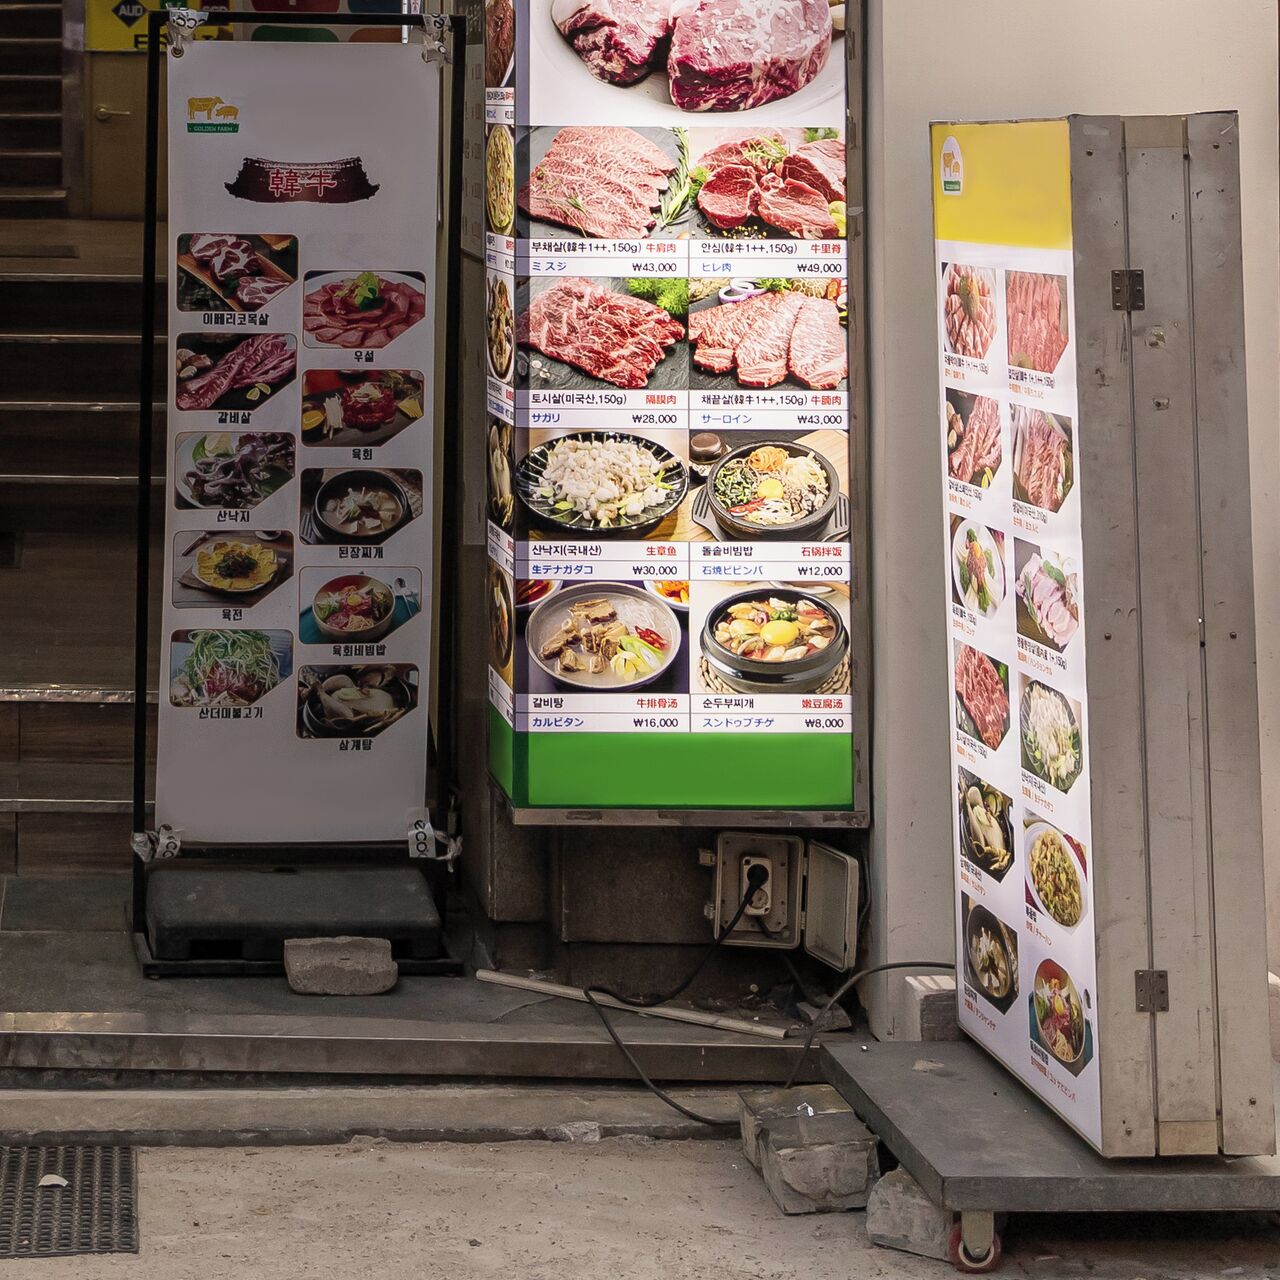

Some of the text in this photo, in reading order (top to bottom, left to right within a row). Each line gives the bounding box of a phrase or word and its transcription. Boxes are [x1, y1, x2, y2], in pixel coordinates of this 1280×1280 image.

[118, 5, 144, 17] AUD
[632, 263, 677, 272] ₩43,000
[797, 264, 842, 273] ₩49,000
[202, 312, 269, 326] 이베리코목살
[531, 394, 627, 404] 토시살(미국산,150g)
[218, 412, 252, 424] 갈비살
[632, 415, 677, 424] ₩28,000
[797, 415, 842, 425] ₩43,000
[338, 546, 384, 559] 된장찌개
[532, 545, 602, 556] 산낙지(국내산)
[702, 546, 753, 557] 돌솥비빔밥
[632, 566, 677, 575] ₩30,000
[798, 567, 843, 576] ₩12,000
[222, 609, 243, 621] 육전
[332, 644, 387, 656] 육회비빔밥
[533, 697, 563, 708] 갈비탕
[703, 698, 754, 709] 순두부찌개
[633, 718, 678, 728] ₩16,000
[805, 718, 844, 728] ₩8,000
